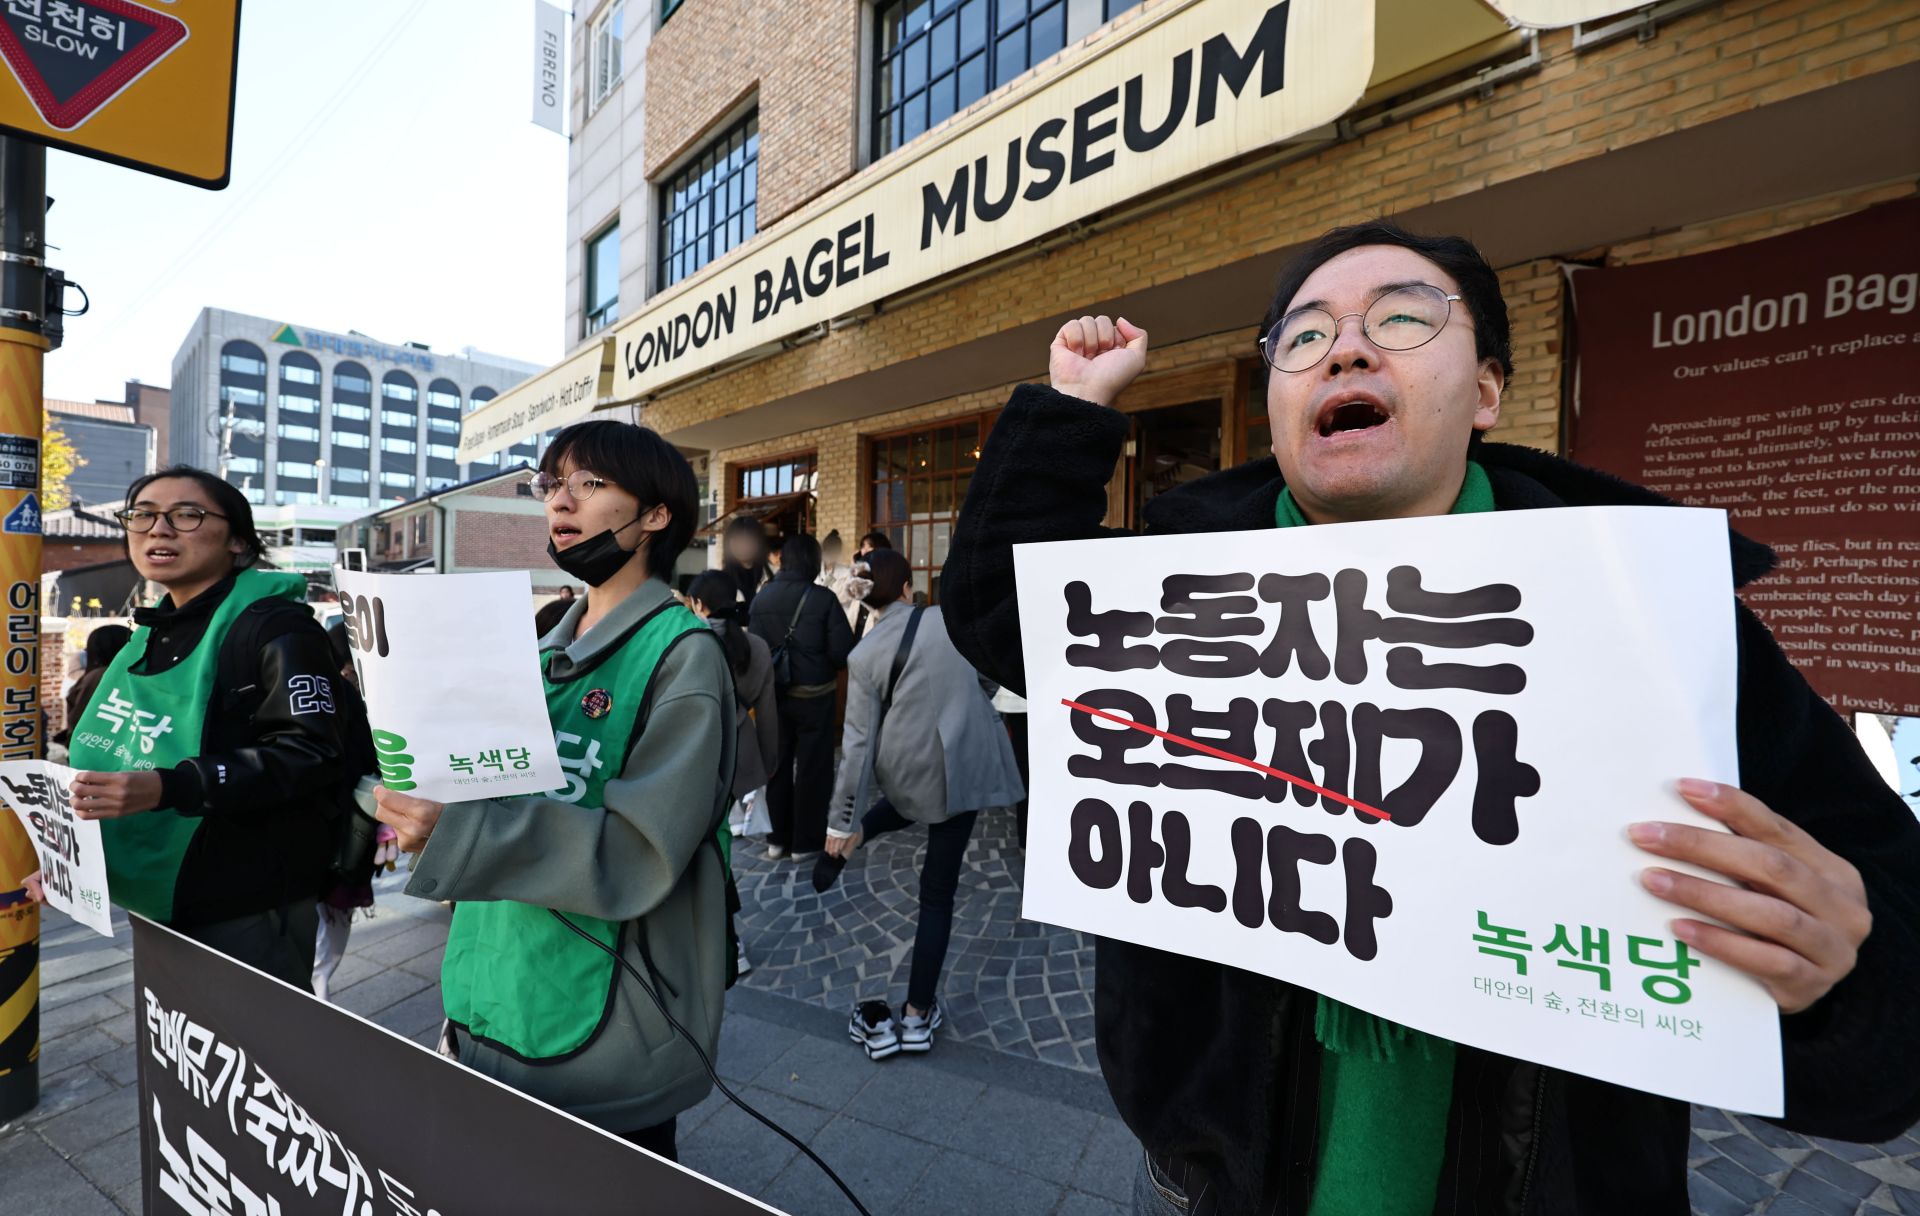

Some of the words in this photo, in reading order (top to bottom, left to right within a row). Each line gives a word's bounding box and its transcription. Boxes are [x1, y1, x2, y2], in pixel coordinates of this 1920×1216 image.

[24, 25, 99, 60] SLOW
[541, 30, 557, 108] FIBRENO
[624, 286, 737, 380] LONDON
[752, 212, 891, 323] BAGEL
[919, 0, 1291, 250] MUSEUM
[1652, 292, 1808, 349] London
[1824, 273, 1920, 319] Bag
[1673, 366, 1707, 379] Our
[1712, 357, 1770, 375] values
[1774, 345, 1824, 364] can't
[1829, 333, 1906, 355] replace
[1647, 415, 1742, 435] Approaching
[1746, 413, 1772, 424] me
[1775, 405, 1813, 420] with
[1817, 402, 1846, 415] my
[1849, 397, 1888, 409] ears
[1722, 428, 1752, 442] and
[1755, 422, 1814, 442] pulling
[1818, 419, 1841, 433] up
[1844, 415, 1869, 430] by
[1644, 453, 1665, 463] we
[1667, 450, 1708, 462] know
[1837, 431, 1881, 446] what
[1642, 466, 1696, 479] tending
[1698, 464, 1723, 475] not
[1727, 463, 1743, 473] to
[1746, 457, 1791, 471] know
[1794, 453, 1834, 466] what
[1839, 450, 1866, 462] we
[1674, 482, 1690, 491] as
[1693, 481, 1703, 490] a
[1705, 474, 1776, 490] cowardly
[1778, 466, 1871, 484] dereliction
[1874, 464, 1898, 477] of
[1682, 494, 1705, 505] the
[1762, 488, 1788, 501] the
[1834, 486, 1855, 497] or
[1858, 482, 1888, 495] the
[1729, 507, 1762, 519] And
[1767, 507, 1790, 516] we
[1794, 504, 1835, 516] must
[1840, 501, 1863, 513] do
[1867, 503, 1888, 512] so
[1772, 542, 1799, 553] ime
[1844, 538, 1872, 551] but
[1877, 539, 1893, 551] in
[1813, 556, 1878, 571] Perhaps
[1881, 556, 1909, 568] the
[1796, 573, 1826, 585] and
[1749, 590, 1832, 604] embracing
[1835, 590, 1874, 602] each
[1877, 590, 1910, 606] day
[5, 581, 40, 675] 어린이
[1770, 606, 1828, 620] people.
[1832, 606, 1862, 618] I've
[1864, 610, 1913, 621] come
[1064, 565, 1535, 695] 노동자는
[1781, 623, 1834, 634] results
[1838, 624, 1861, 635] of
[1826, 659, 1842, 668] in
[1847, 658, 1890, 673] ways
[287, 674, 337, 716] 25
[76, 732, 115, 752] 대안의
[448, 747, 535, 775] 녹색당
[1061, 688, 1541, 846] 오브제가
[1067, 797, 1393, 962] 아니다
[1472, 910, 1700, 1005] 녹색당
[1473, 976, 1534, 1005] 대안의
[1543, 991, 1571, 1013] 숲,
[1577, 997, 1645, 1029] 전환의
[1655, 1014, 1704, 1041] 씨앗
